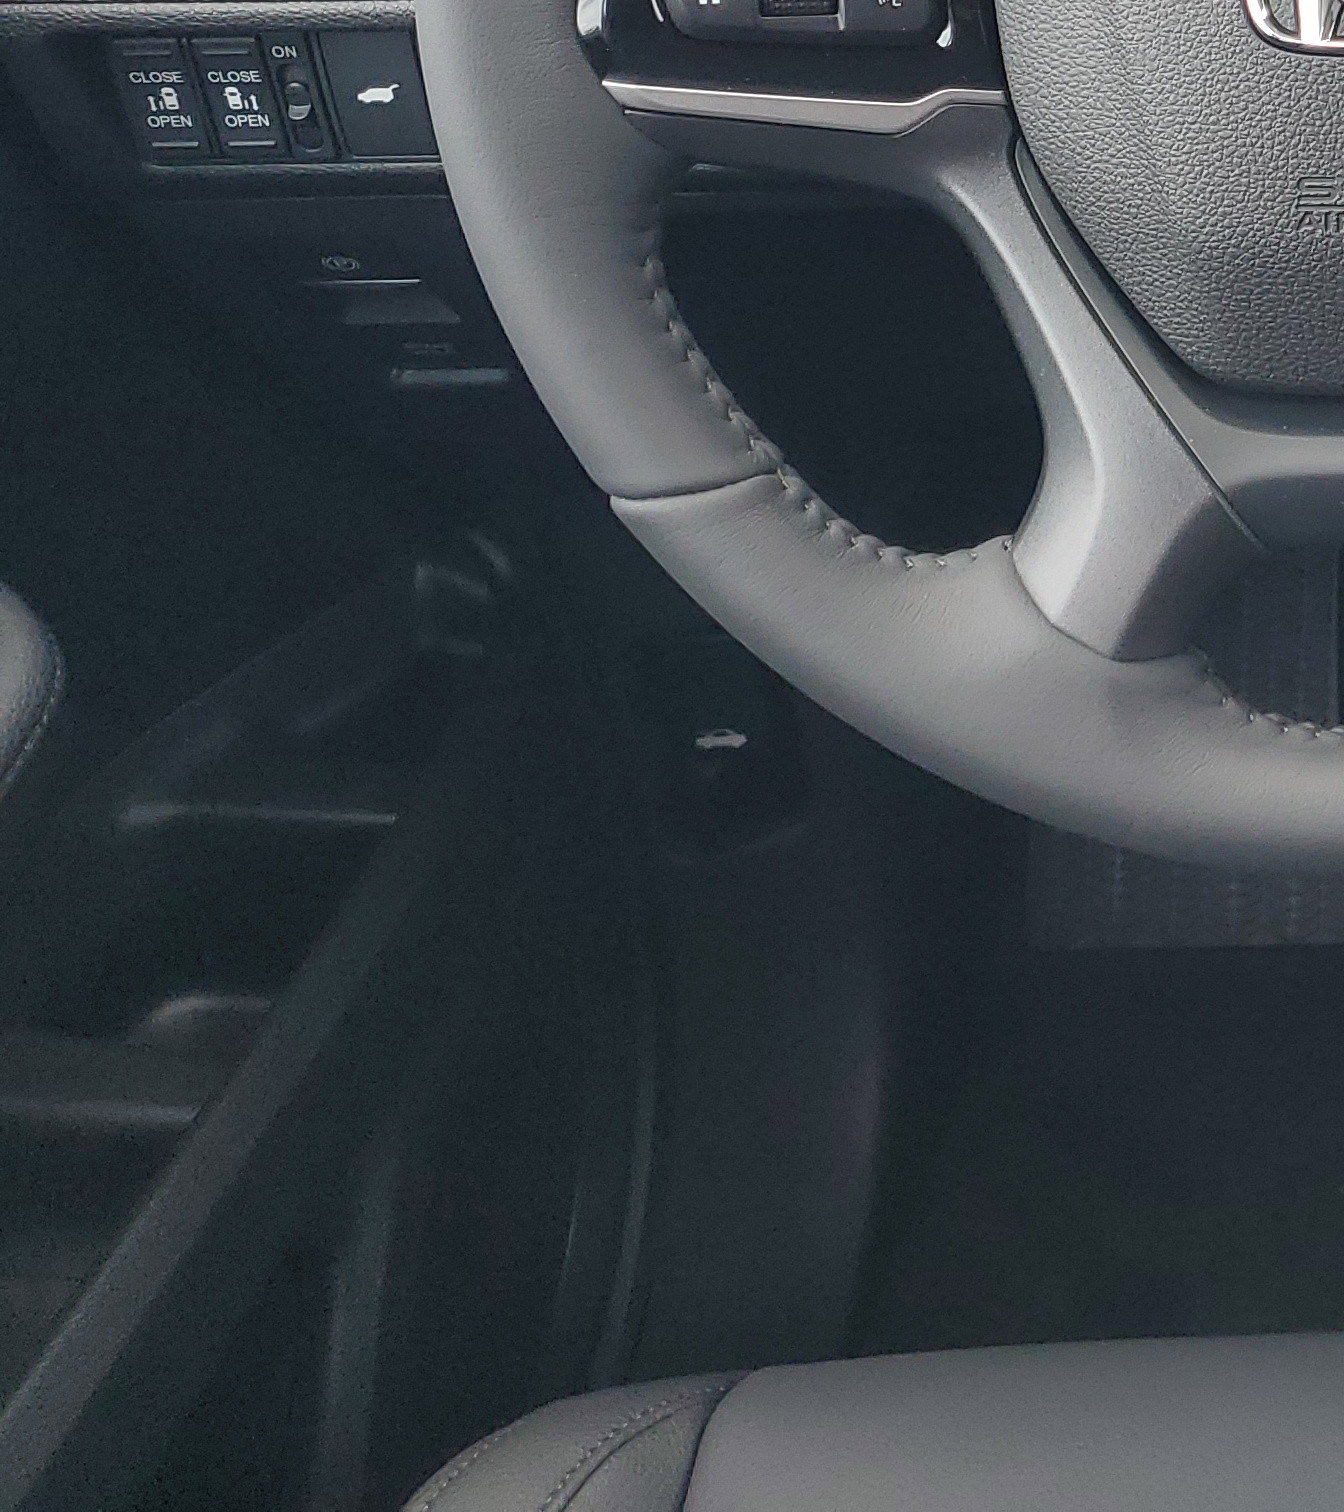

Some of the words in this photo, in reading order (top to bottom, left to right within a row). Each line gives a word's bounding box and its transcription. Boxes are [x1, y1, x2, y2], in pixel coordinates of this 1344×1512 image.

[271, 45, 298, 59] ON
[129, 70, 184, 85] CLOSE
[207, 70, 262, 84] CLOSE
[146, 114, 193, 129] OPEN
[224, 113, 271, 129] OPEN
